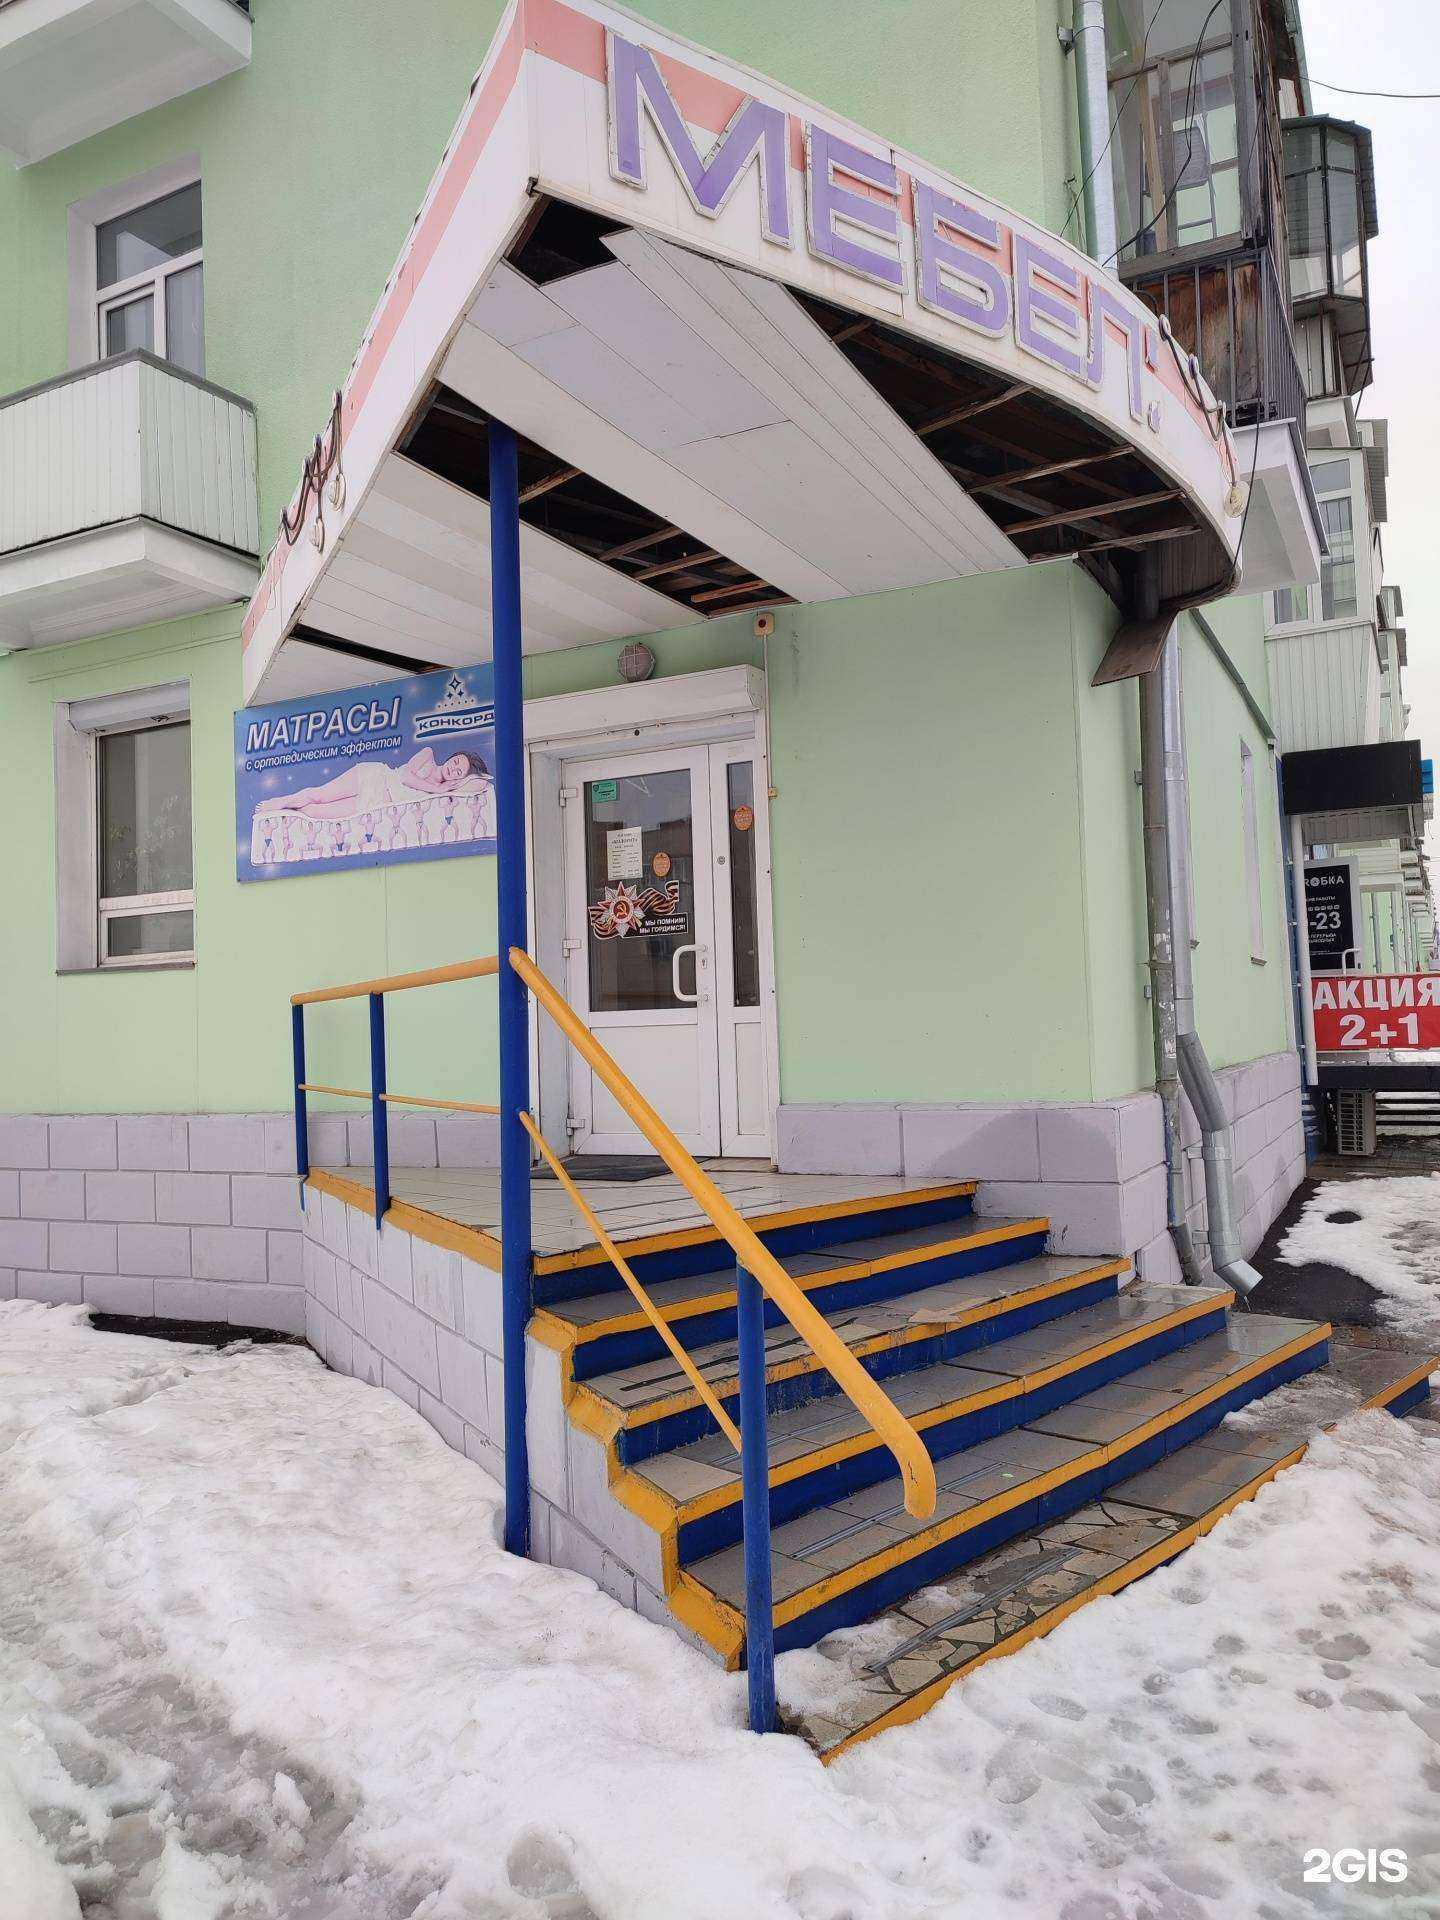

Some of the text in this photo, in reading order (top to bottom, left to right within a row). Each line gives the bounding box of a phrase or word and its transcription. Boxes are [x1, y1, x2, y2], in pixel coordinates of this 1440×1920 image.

[246, 697, 401, 751] МАТРАСЫ
[420, 712, 495, 730] КОНКОРД
[246, 736, 401, 772] с ортопедическим эффектом
[645, 917, 686, 927] МЫ ПОМНИМ!
[651, 925, 686, 933] ГОРДИМСЯ!
[1313, 977, 1440, 1010] АКЦИЯ
[1340, 1013, 1419, 1046] 2+1
